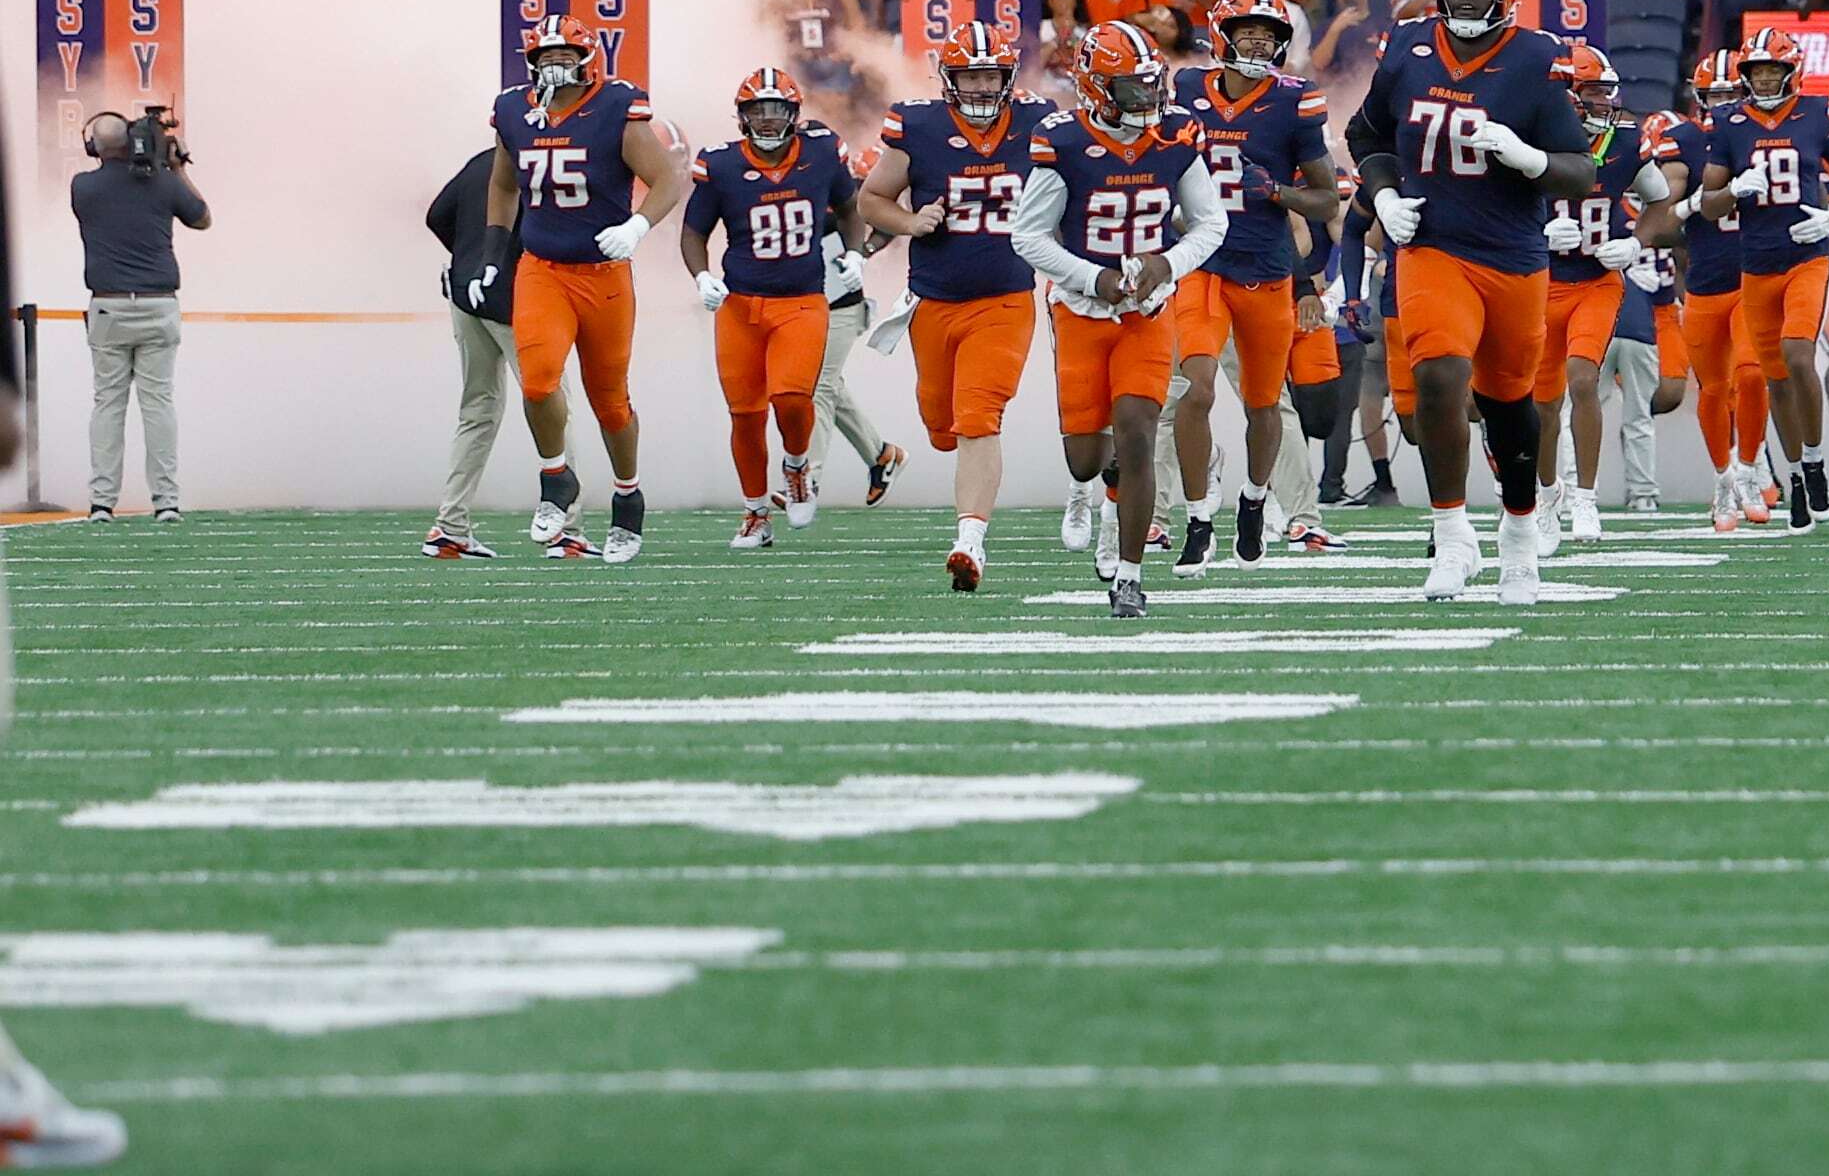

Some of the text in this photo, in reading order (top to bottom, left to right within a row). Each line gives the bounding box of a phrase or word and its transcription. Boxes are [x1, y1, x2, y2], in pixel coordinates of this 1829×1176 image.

[1428, 86, 1475, 103] ORANGE
[533, 136, 572, 147] ORANGE
[1206, 130, 1249, 141] ORANGE
[518, 147, 590, 209] 75
[964, 163, 1008, 176] ORANGE
[1105, 173, 1156, 186] ORANGE
[1750, 147, 1801, 207] 19
[946, 174, 1024, 235] 53
[1086, 187, 1172, 256] 22
[750, 199, 814, 261] 88
